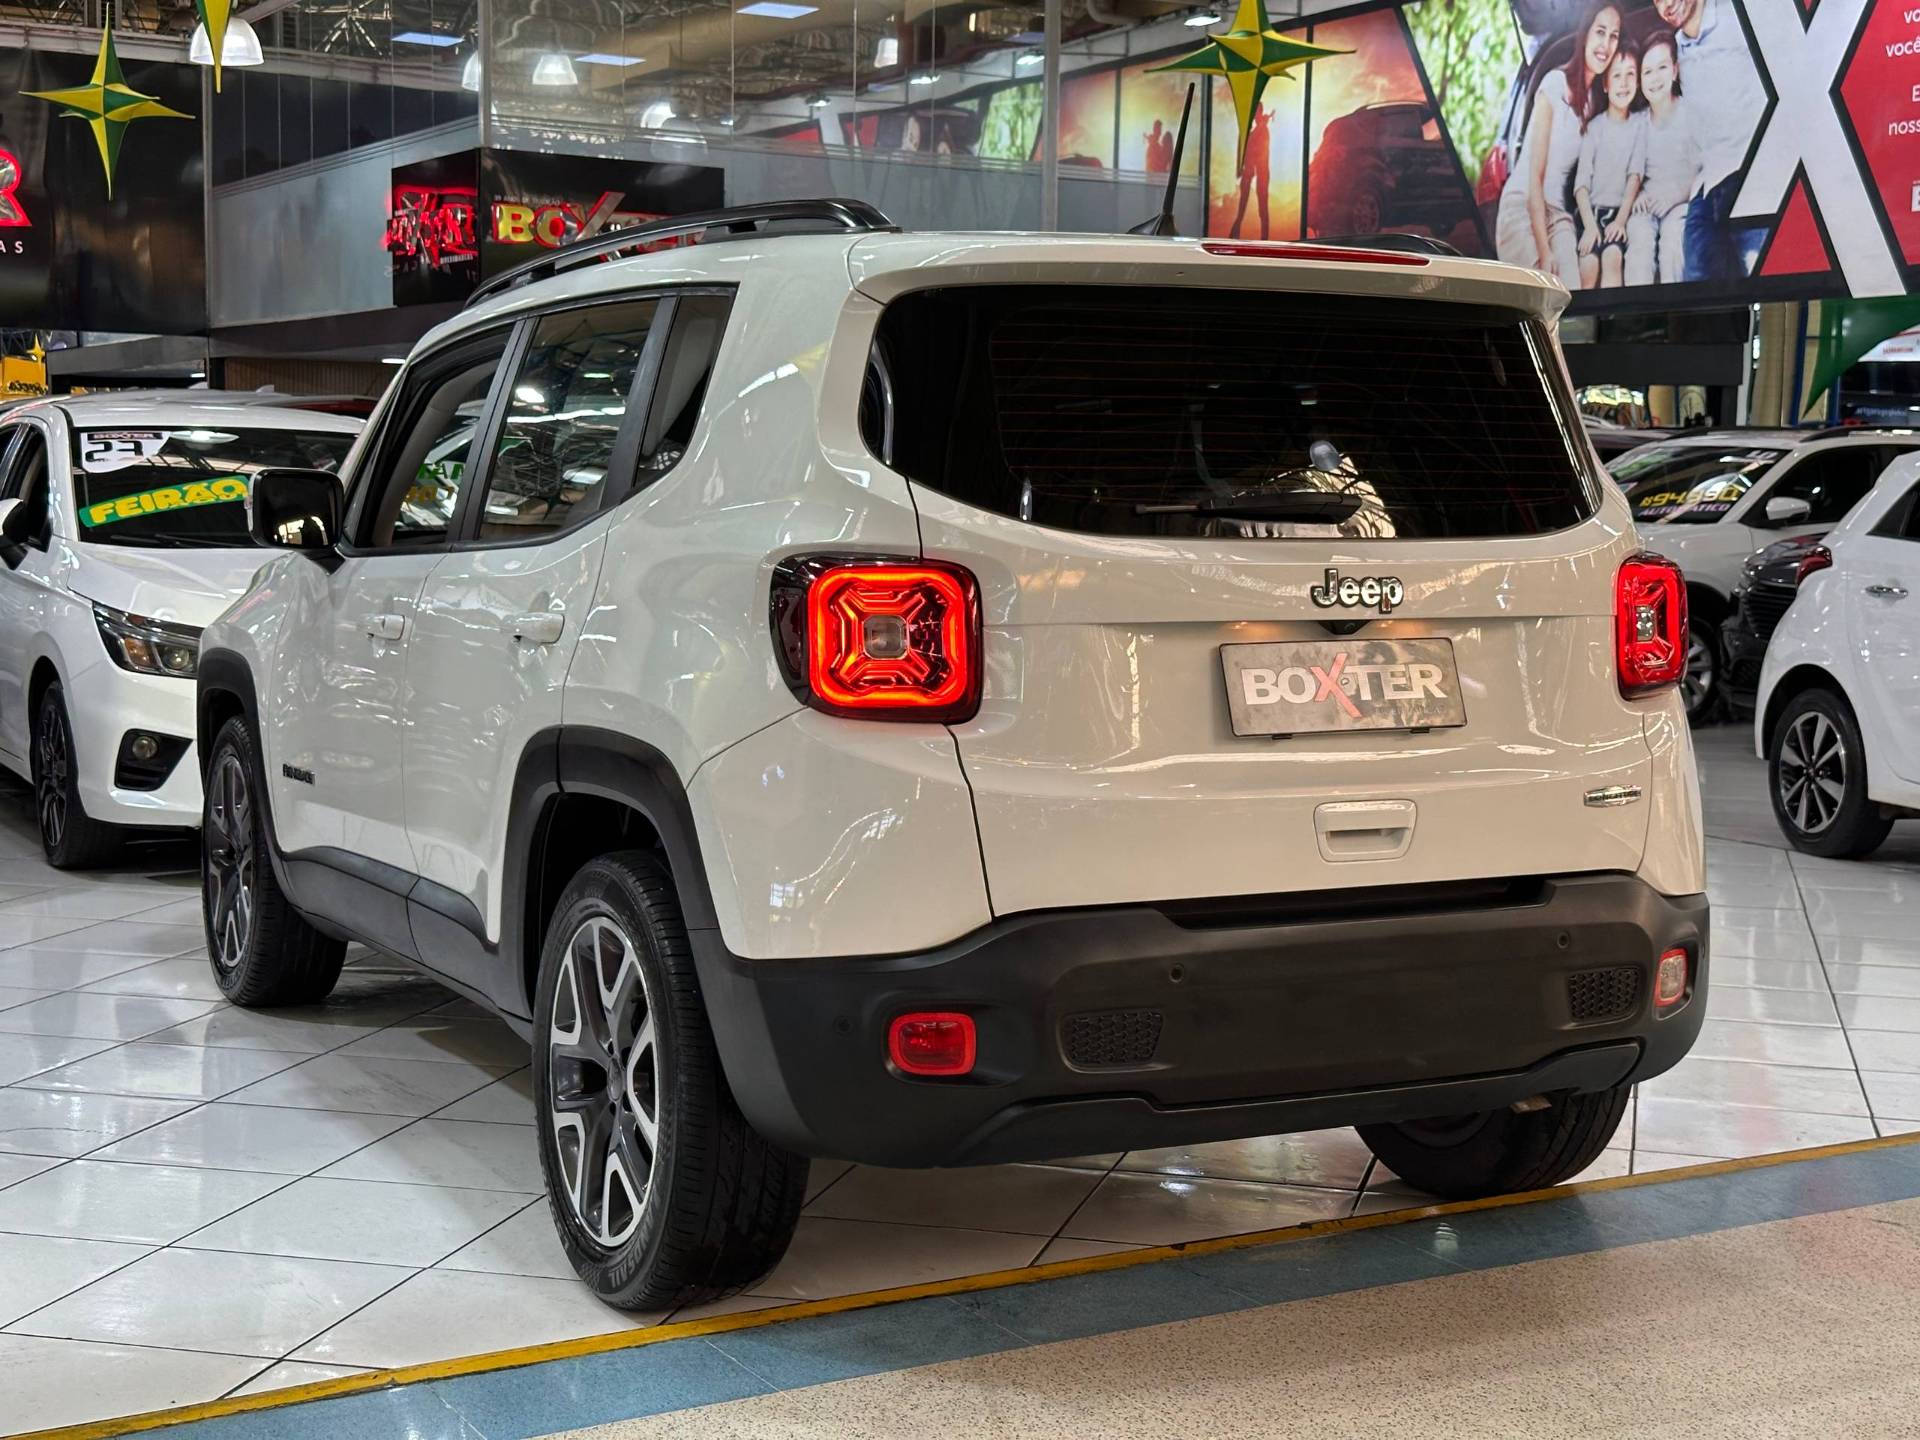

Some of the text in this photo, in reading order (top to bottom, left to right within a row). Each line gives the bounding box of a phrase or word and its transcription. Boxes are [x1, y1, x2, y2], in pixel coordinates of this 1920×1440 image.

[89, 478, 249, 525] FEIRÃO
[1310, 568, 1404, 614] Jeep
[1240, 652, 1448, 718] BOXTER
